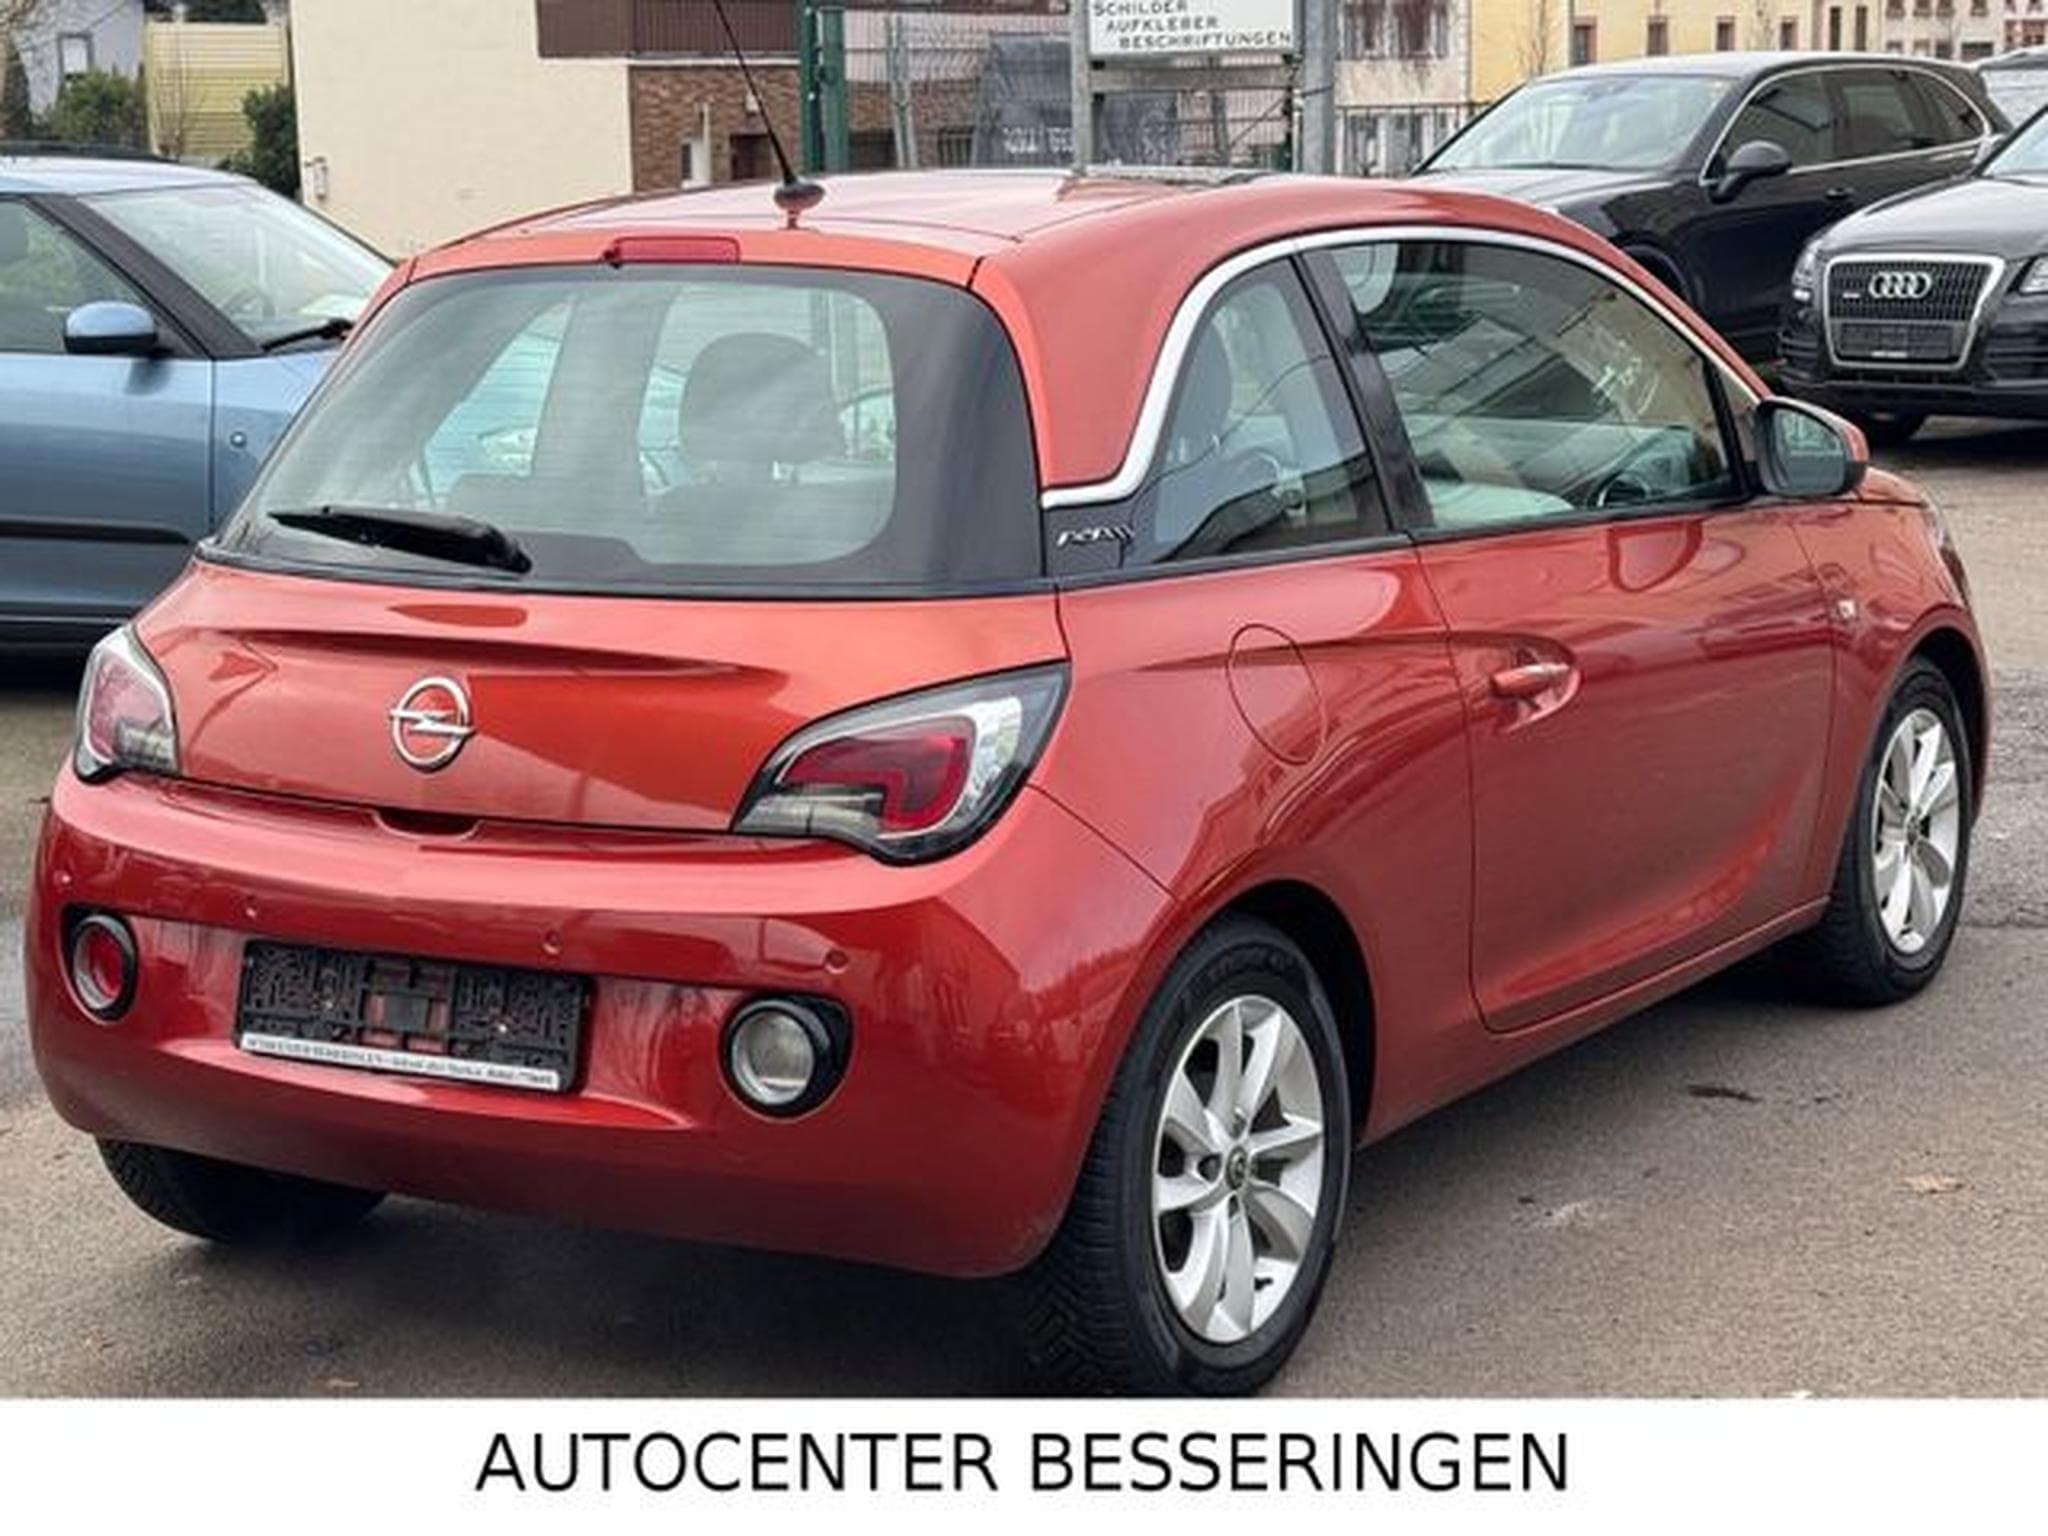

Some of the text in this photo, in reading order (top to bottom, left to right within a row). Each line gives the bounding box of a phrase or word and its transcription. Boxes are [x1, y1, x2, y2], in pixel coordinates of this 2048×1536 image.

[1093, 0, 1188, 17] SCHILDER
[1106, 16, 1218, 33] AUFKLEBER
[1119, 31, 1291, 48] BESCHRIFTUNGEN
